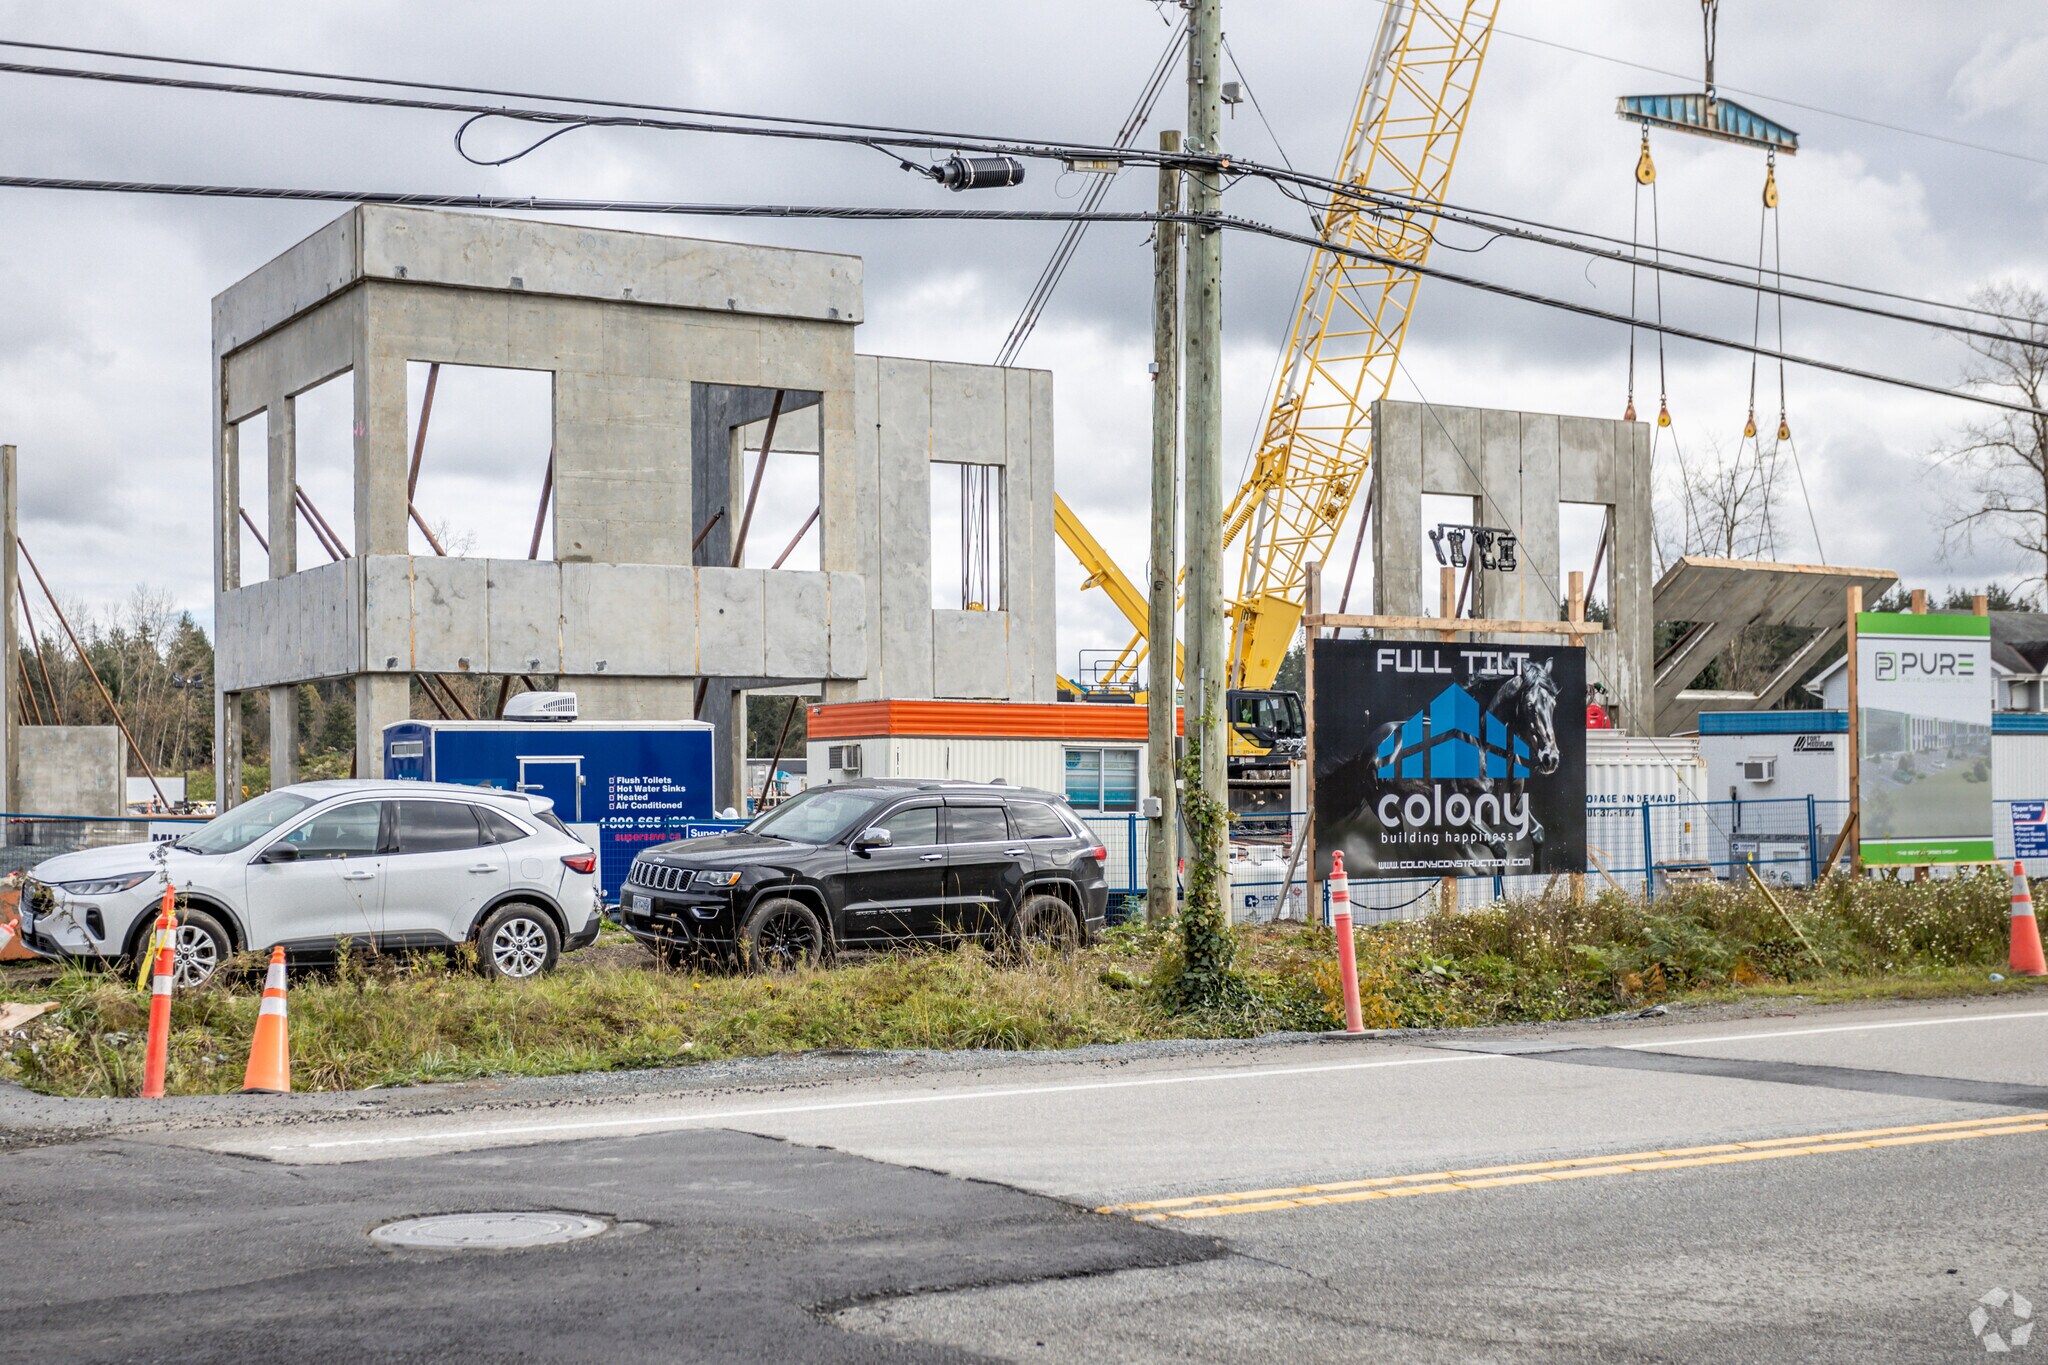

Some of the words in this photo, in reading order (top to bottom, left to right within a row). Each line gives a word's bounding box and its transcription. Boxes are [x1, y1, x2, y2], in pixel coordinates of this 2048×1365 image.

[1377, 648, 1452, 673] FULL
[1460, 650, 1530, 675] TILT
[1902, 652, 1974, 676] PURE
[616, 776, 640, 784] Flush
[642, 776, 672, 784] Toilets
[616, 785, 633, 793] Hot
[662, 784, 686, 792] Sinks
[616, 793, 648, 801] Heated
[1586, 794, 1618, 803] ORAGE
[630, 801, 683, 809] Conditioned
[1378, 784, 1530, 841] colony
[614, 832, 682, 844] supersaveca
[1381, 831, 1439, 846] building
[1445, 831, 1514, 845] happiness
